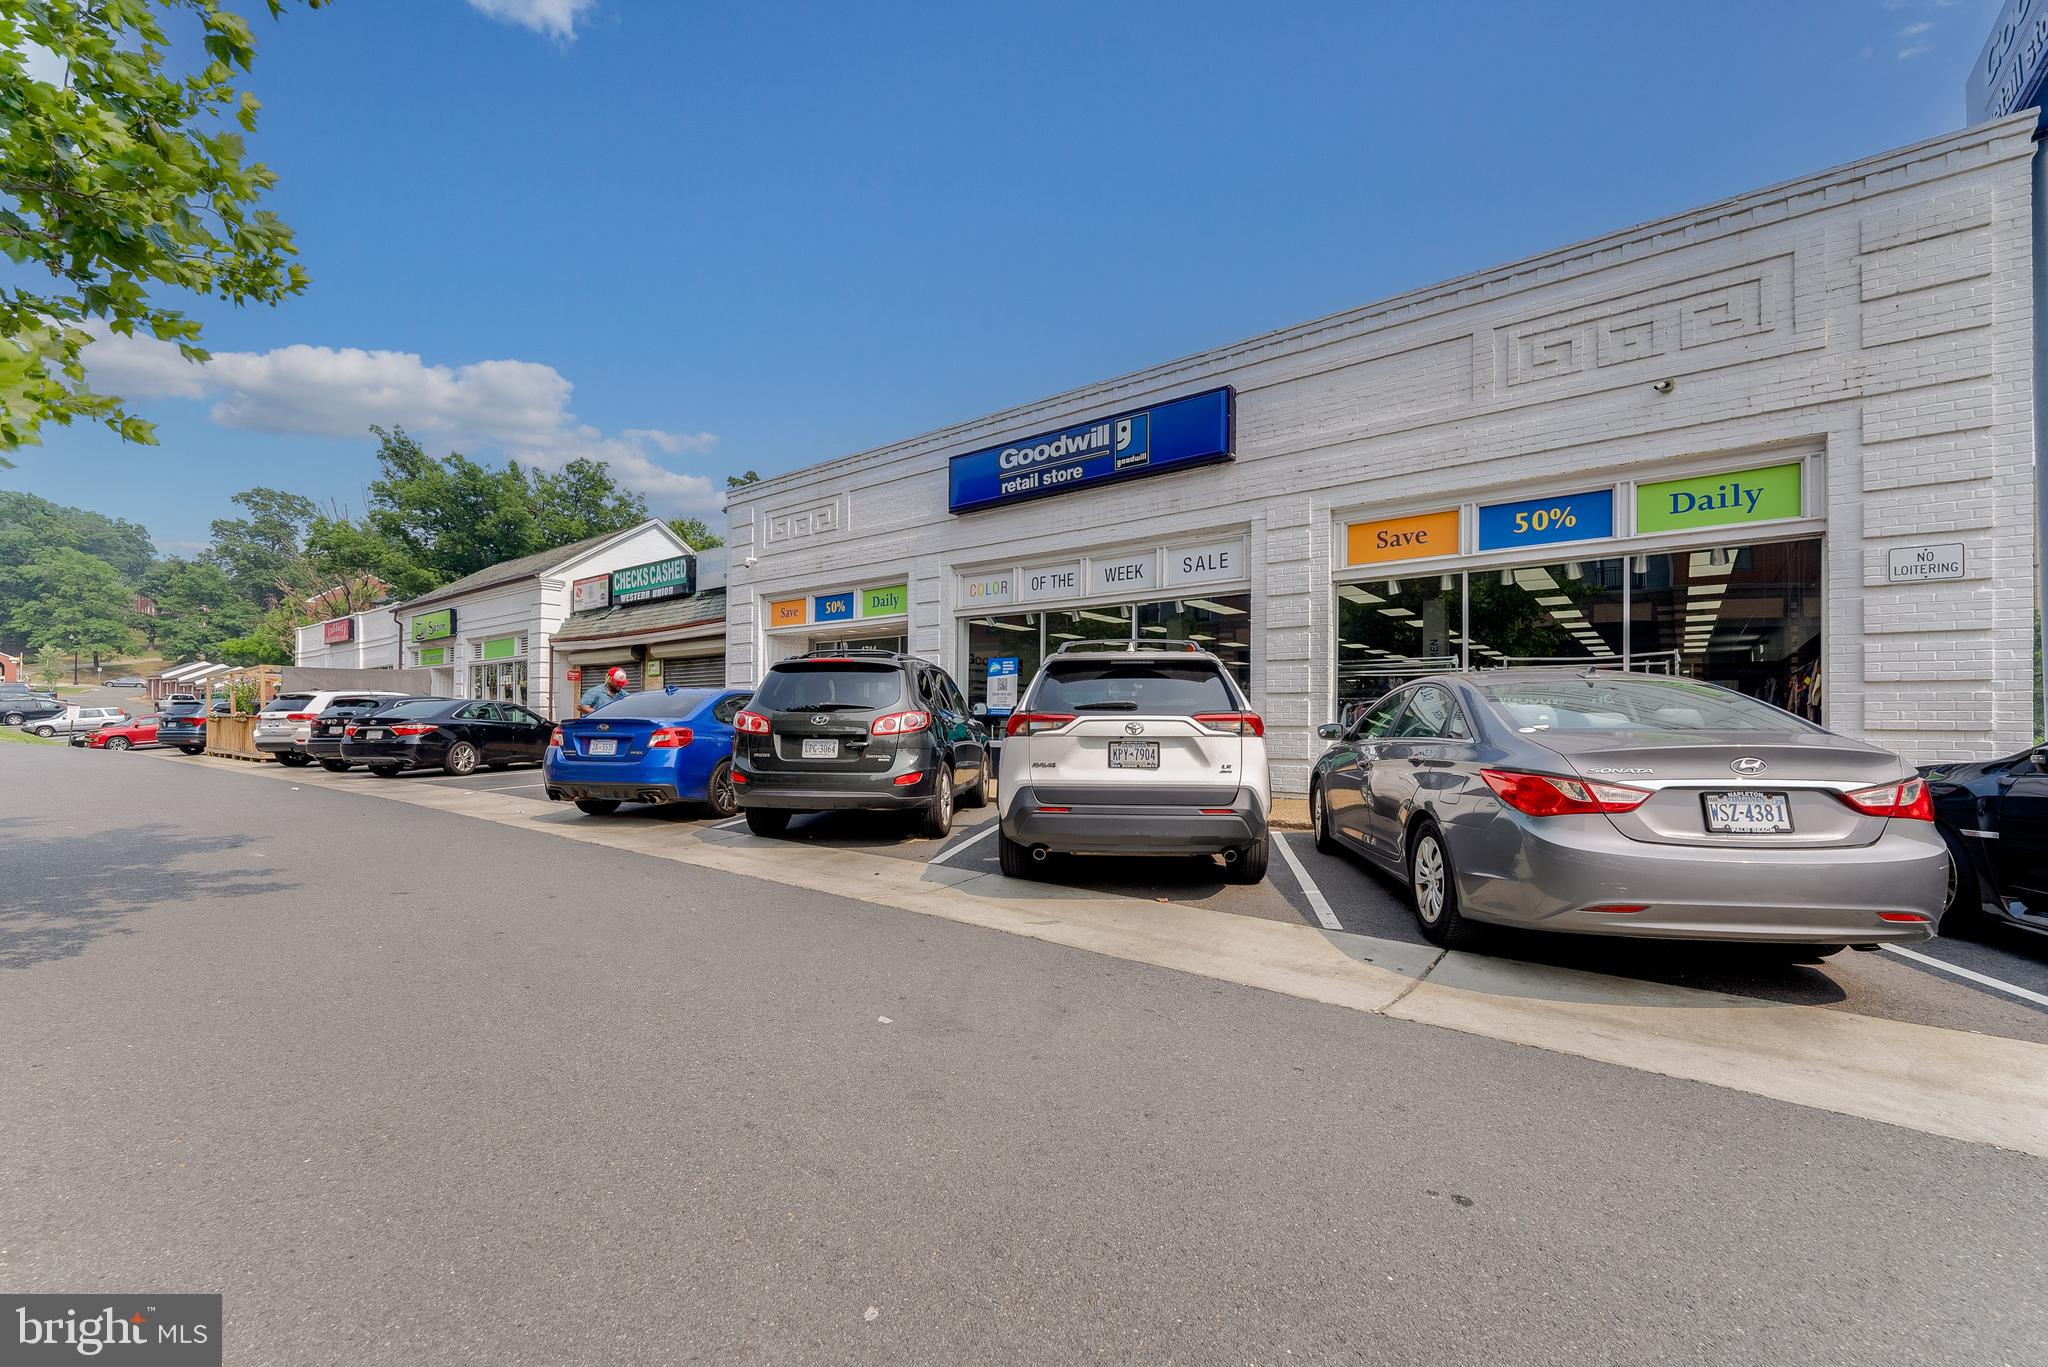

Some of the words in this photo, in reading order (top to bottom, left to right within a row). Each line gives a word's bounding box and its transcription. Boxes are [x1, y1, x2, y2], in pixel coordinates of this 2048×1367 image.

[999, 423, 1110, 470] Goodwill
[1116, 453, 1147, 468] goodwill
[1001, 471, 1039, 494] retail
[1043, 467, 1083, 485] store
[1669, 483, 1765, 515] Daily
[1512, 506, 1577, 534] 50%
[1376, 529, 1428, 550] Save
[1917, 551, 1934, 562] NO
[614, 567, 649, 591] CHECKS
[650, 558, 686, 585] CASHED
[969, 580, 1008, 597] COLOR
[1031, 575, 1046, 591] OF
[1050, 572, 1075, 588] THE
[1104, 563, 1144, 583] WEEK
[1183, 552, 1229, 573] SALE
[1894, 562, 1959, 576] LOITERING
[620, 590, 650, 602] WESTERN
[652, 586, 674, 598] UNION
[872, 593, 899, 610] Daily
[780, 607, 799, 618] Save
[825, 600, 846, 614] 50%
[1709, 804, 1785, 822] WSZ-4381
